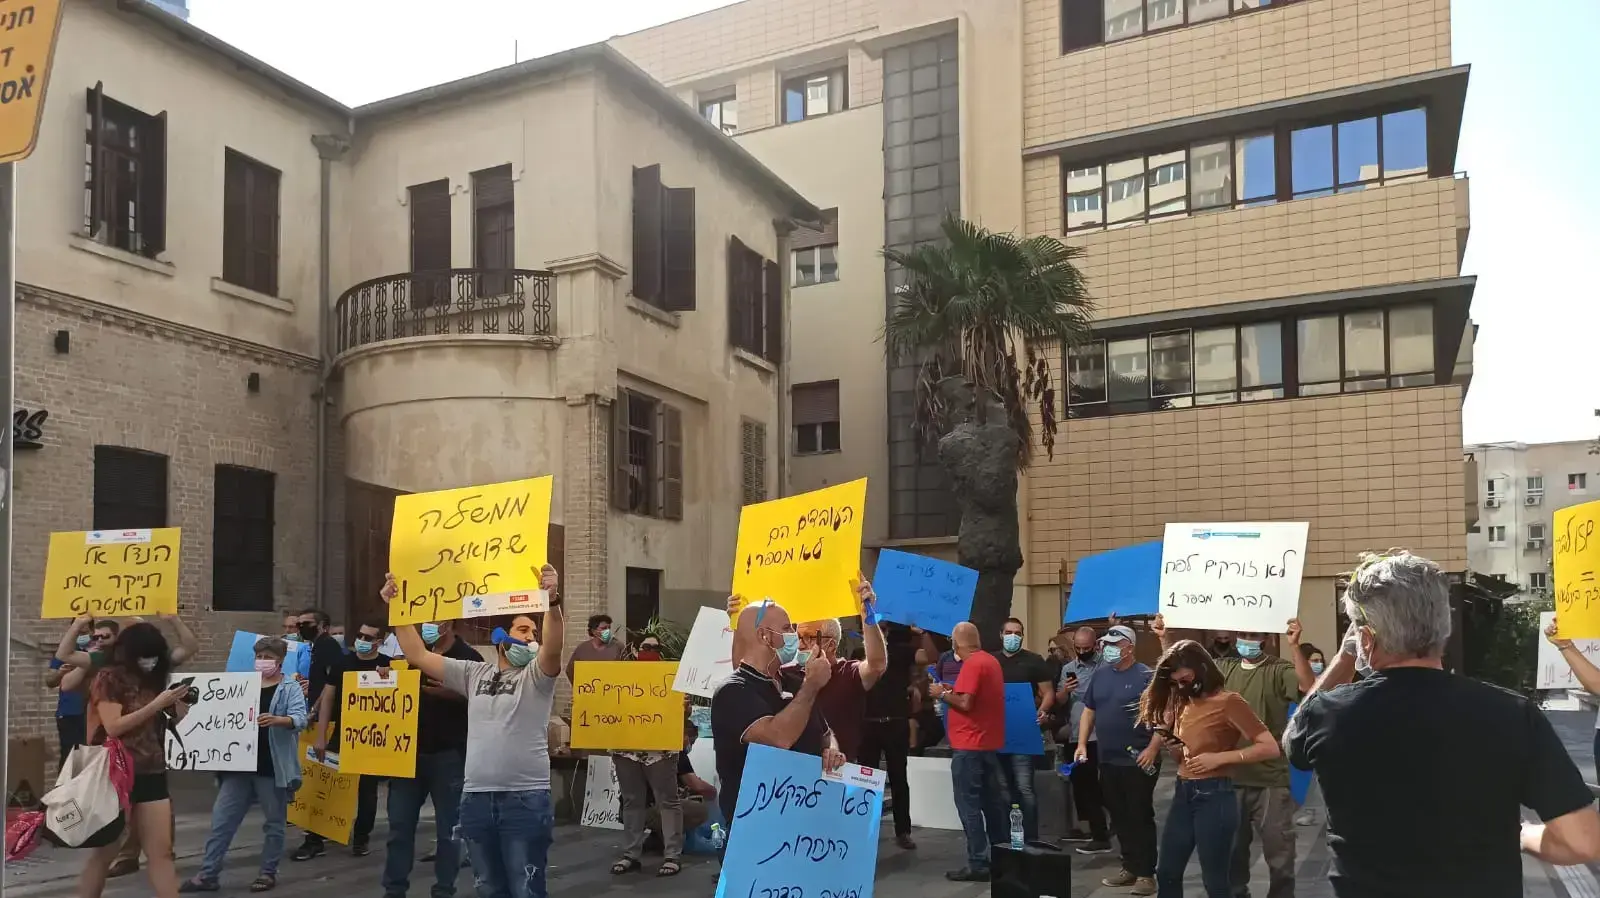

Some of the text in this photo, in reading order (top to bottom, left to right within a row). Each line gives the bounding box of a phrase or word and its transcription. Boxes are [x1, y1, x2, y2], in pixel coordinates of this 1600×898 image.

[418, 493, 530, 533] ממשלה
[766, 506, 854, 546] העובדים הם
[84, 543, 172, 566] הנדל אל
[418, 533, 528, 574] שדואגת
[1164, 550, 1297, 580] לא זורקים לפח
[63, 572, 162, 595] תייקר את
[70, 595, 147, 615] האינטרנט
[1166, 591, 1273, 609] חברה מספר 1
[202, 678, 249, 702] ממשל
[578, 673, 678, 705] לא זורקים לפח
[401, 691, 413, 720] כן
[579, 709, 663, 727] חברה מספר 1
[184, 711, 246, 737] שדואגת
[345, 722, 390, 750] לפוליטיקה
[736, 775, 877, 820] לא להקטנת
[757, 835, 850, 865] התחרות
